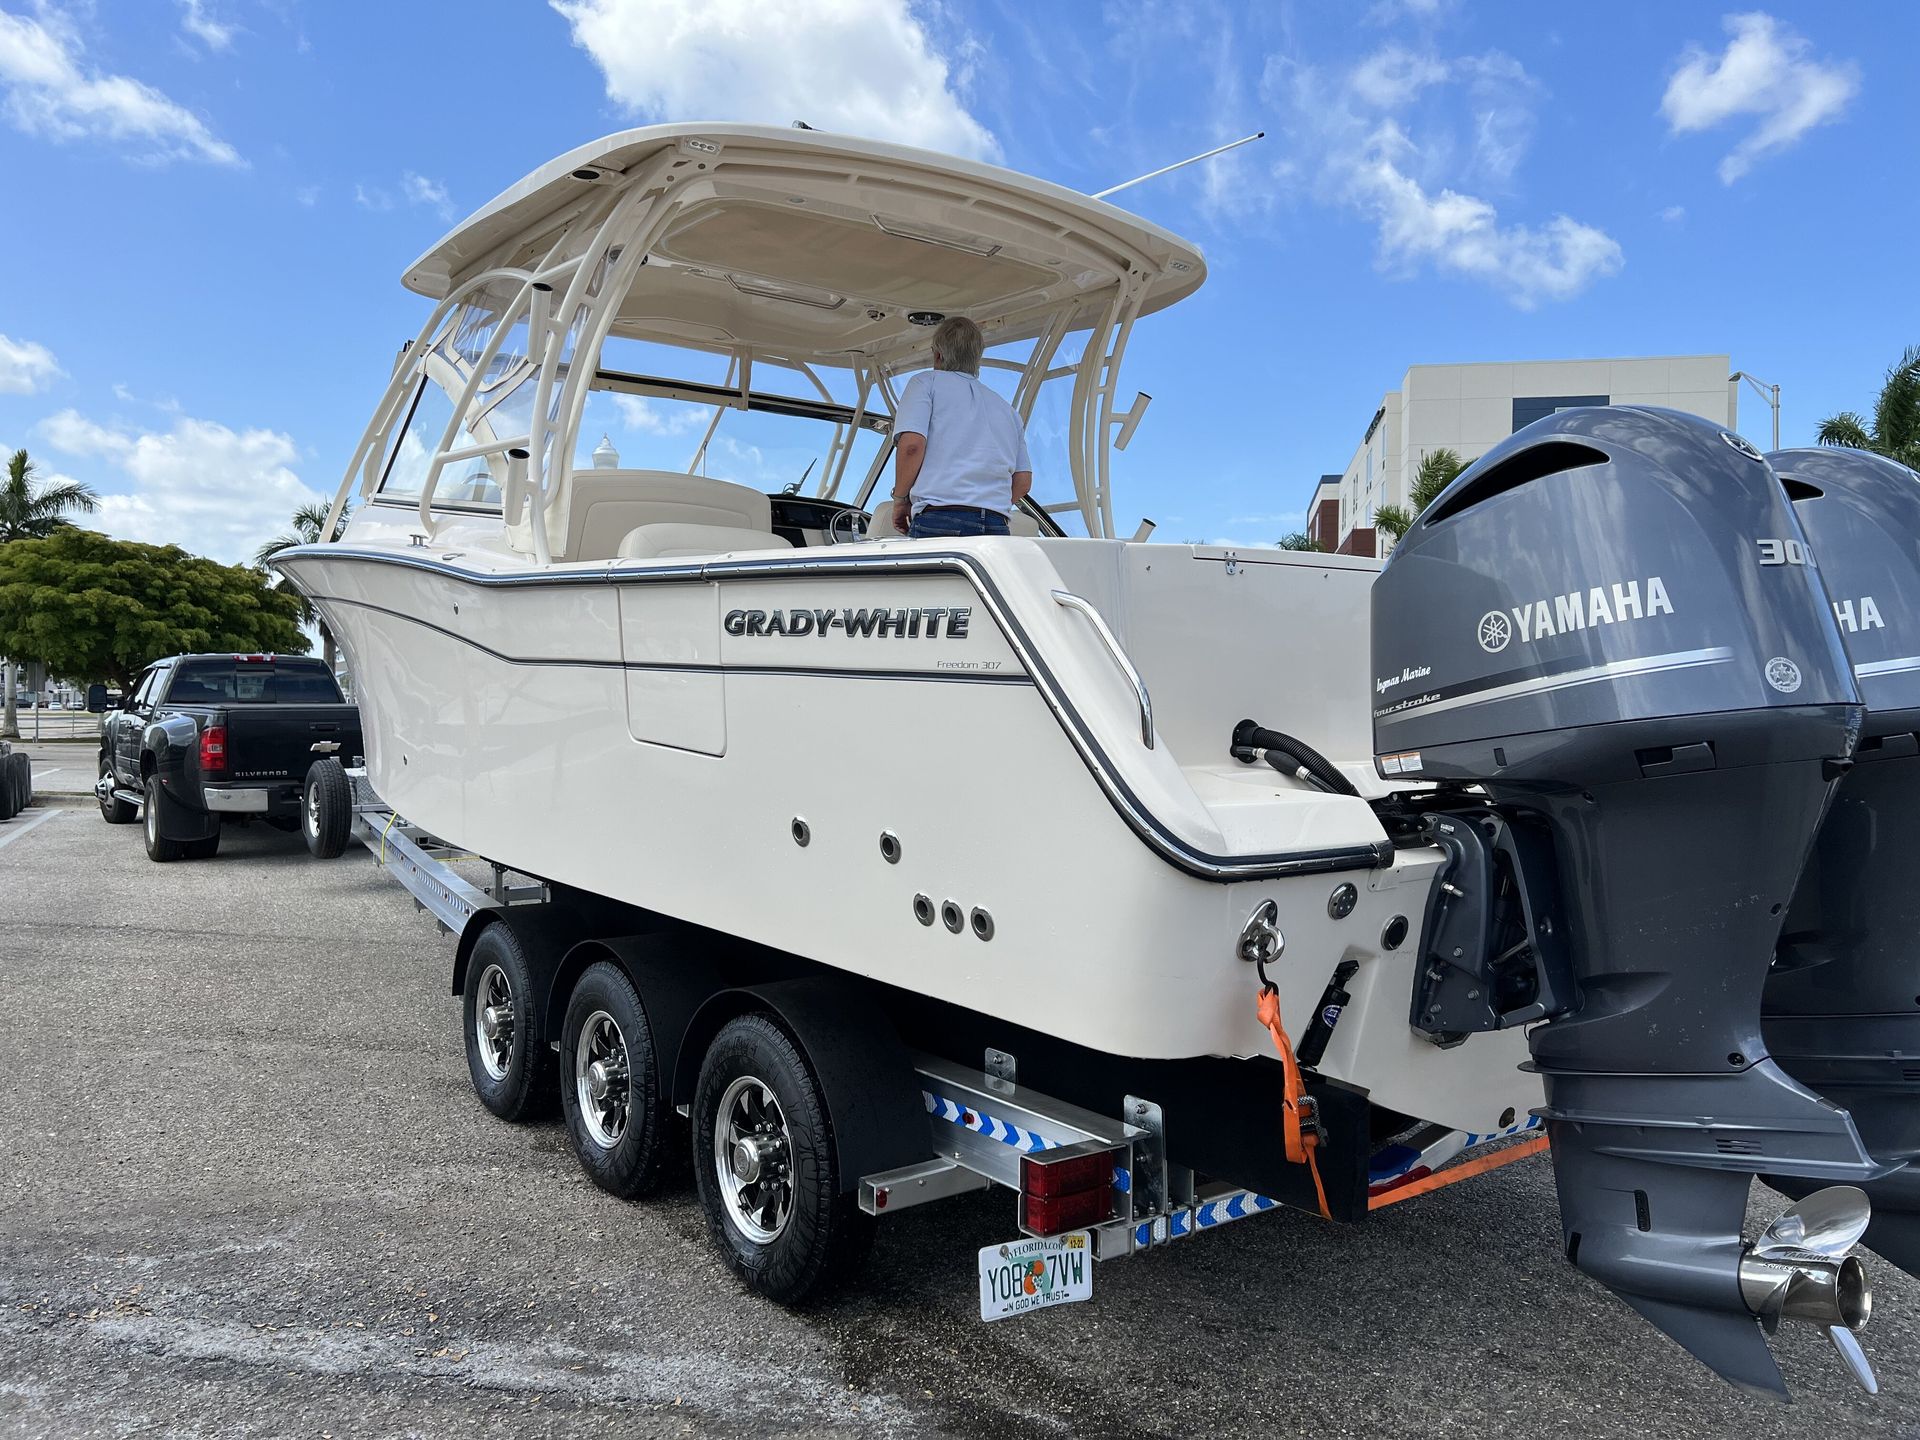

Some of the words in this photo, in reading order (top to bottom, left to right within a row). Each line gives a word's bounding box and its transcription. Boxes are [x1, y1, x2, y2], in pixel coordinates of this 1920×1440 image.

[1757, 539, 1818, 568] 300
[724, 606, 971, 638] GRADY-WHITE
[1512, 577, 1674, 643] YAMAHA
[937, 661, 978, 669] Freedom
[981, 661, 1001, 669] 307
[1401, 667, 1431, 683] Marine
[1784, 1251, 1830, 1262] YAMAHA
[1047, 1252, 1083, 1289] 7VW
[1016, 1298, 1030, 1310] GOD
[1031, 1294, 1040, 1306] WE
[1042, 1290, 1065, 1303] TRUST
